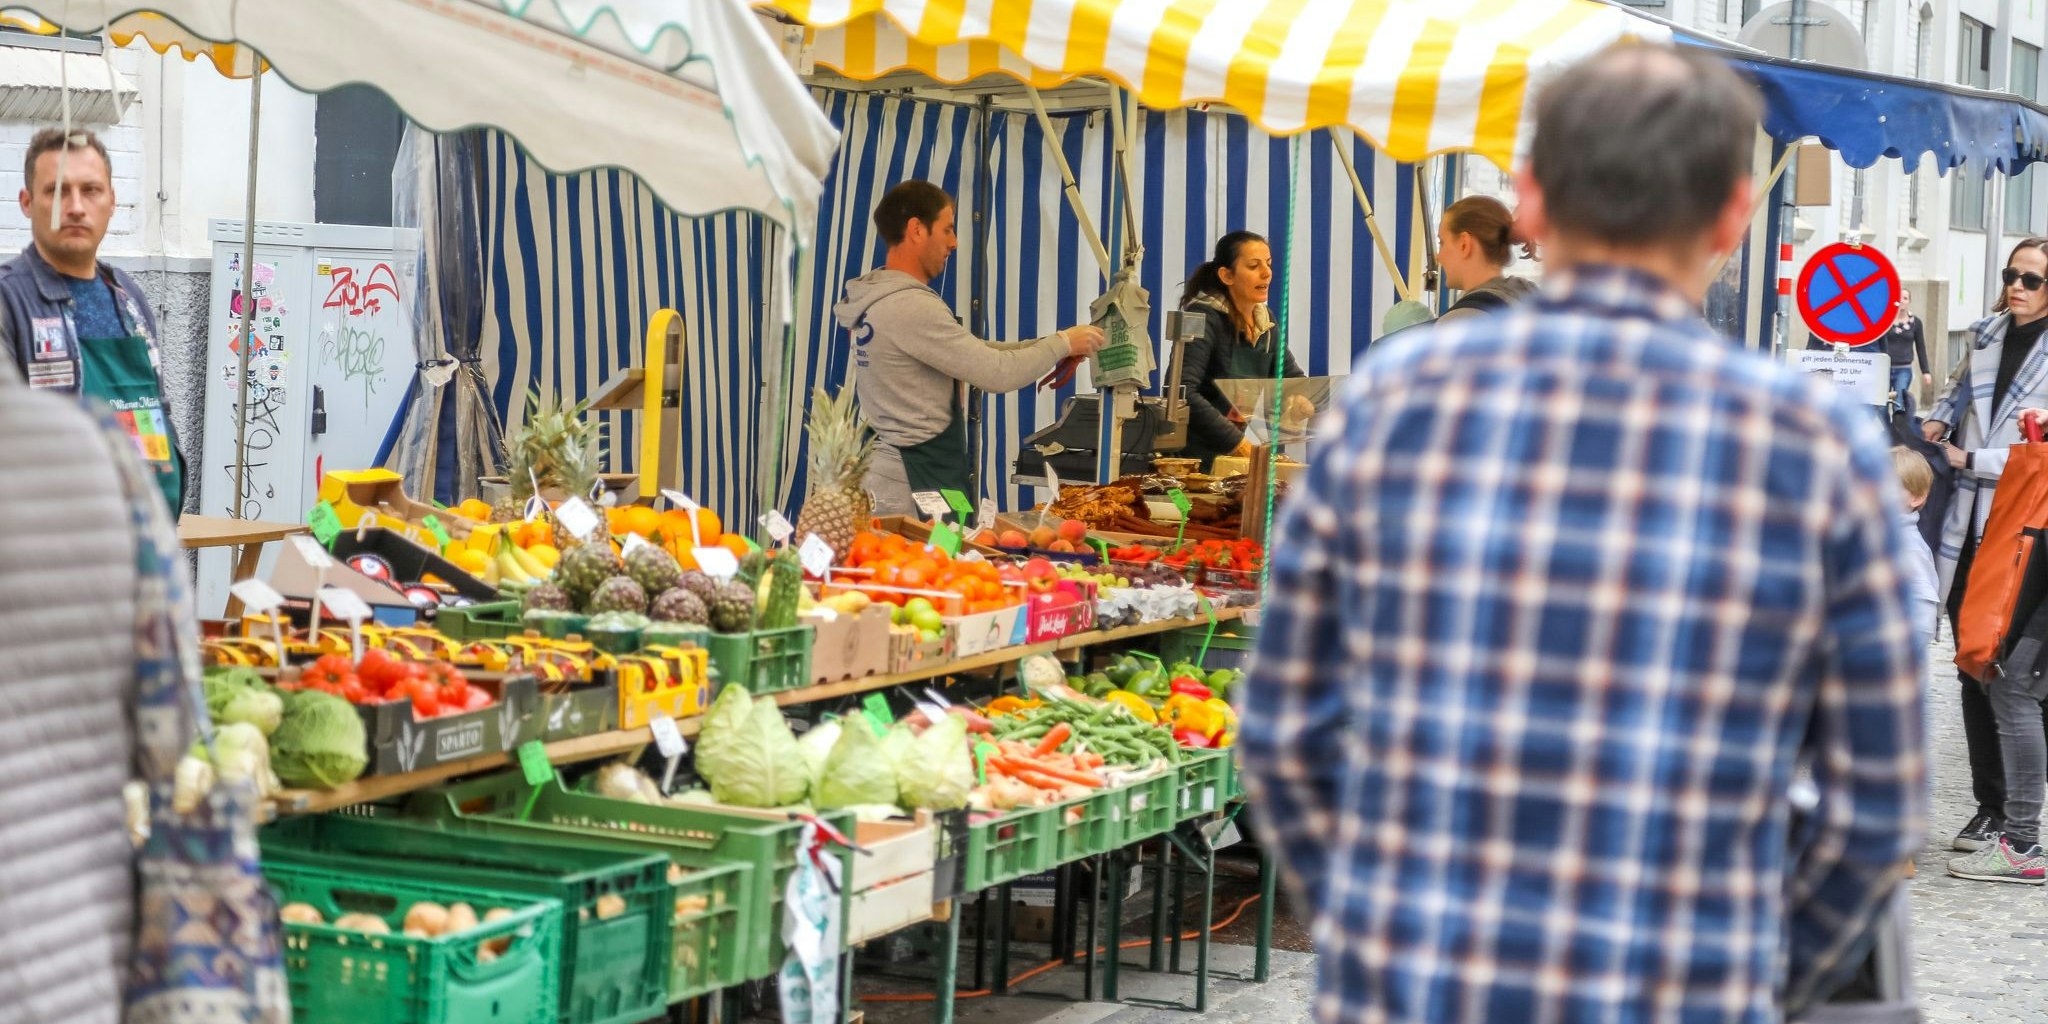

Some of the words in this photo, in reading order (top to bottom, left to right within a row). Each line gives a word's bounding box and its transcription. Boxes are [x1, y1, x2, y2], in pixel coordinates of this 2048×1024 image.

[1111, 330, 1129, 344] BAG
[1834, 356, 1872, 365] Donnerstag
[441, 730, 480, 752] SPARTO
